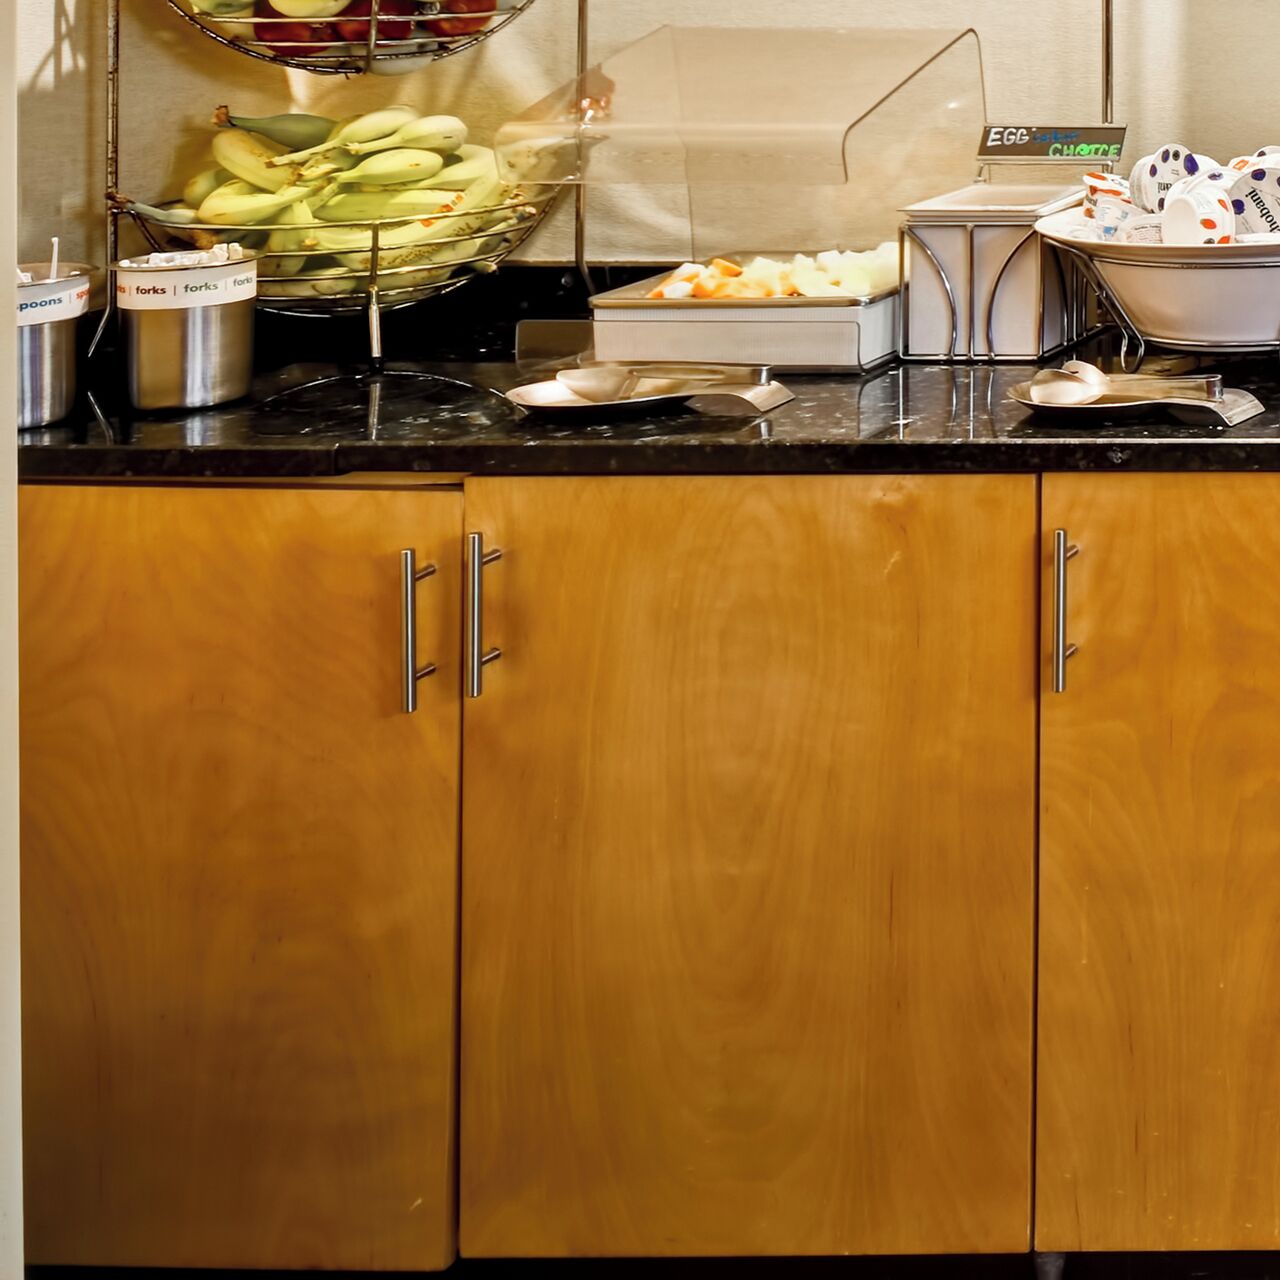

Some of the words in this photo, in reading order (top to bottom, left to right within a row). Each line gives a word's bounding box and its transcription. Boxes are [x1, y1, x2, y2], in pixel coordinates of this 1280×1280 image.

[135, 285, 167, 296] forks
[183, 281, 219, 293] forks
[17, 295, 63, 313] poons
